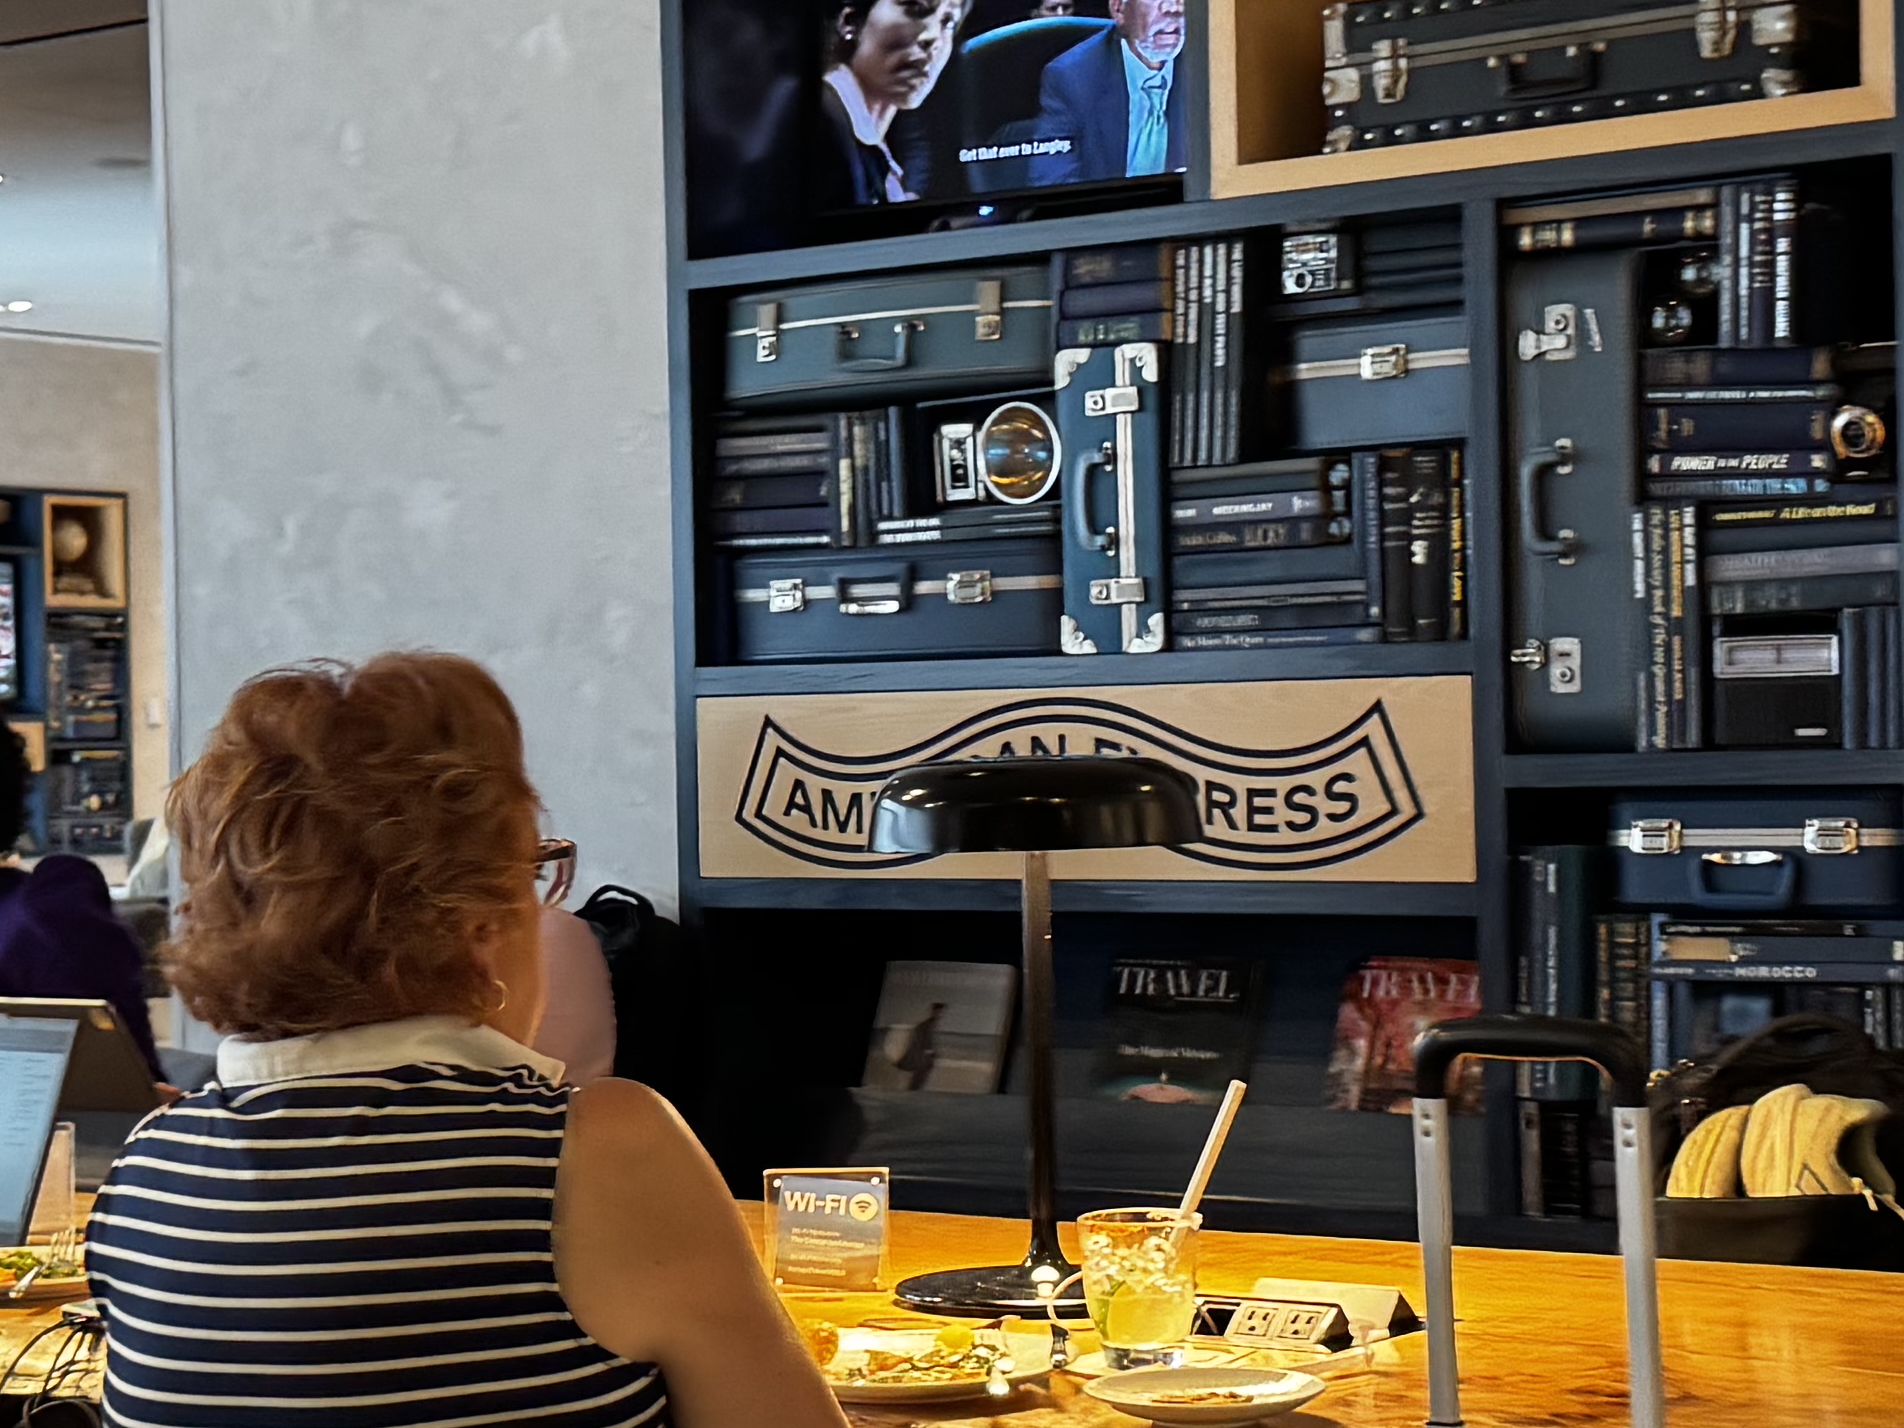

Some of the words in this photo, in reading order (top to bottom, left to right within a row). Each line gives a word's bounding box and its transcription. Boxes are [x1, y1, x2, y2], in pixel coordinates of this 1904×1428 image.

[1741, 453, 1790, 469] PEOPLE
[1114, 966, 1239, 998] TRAVEL
[1735, 965, 1817, 979] MOROCCO
[784, 1190, 847, 1215] WI-FI
